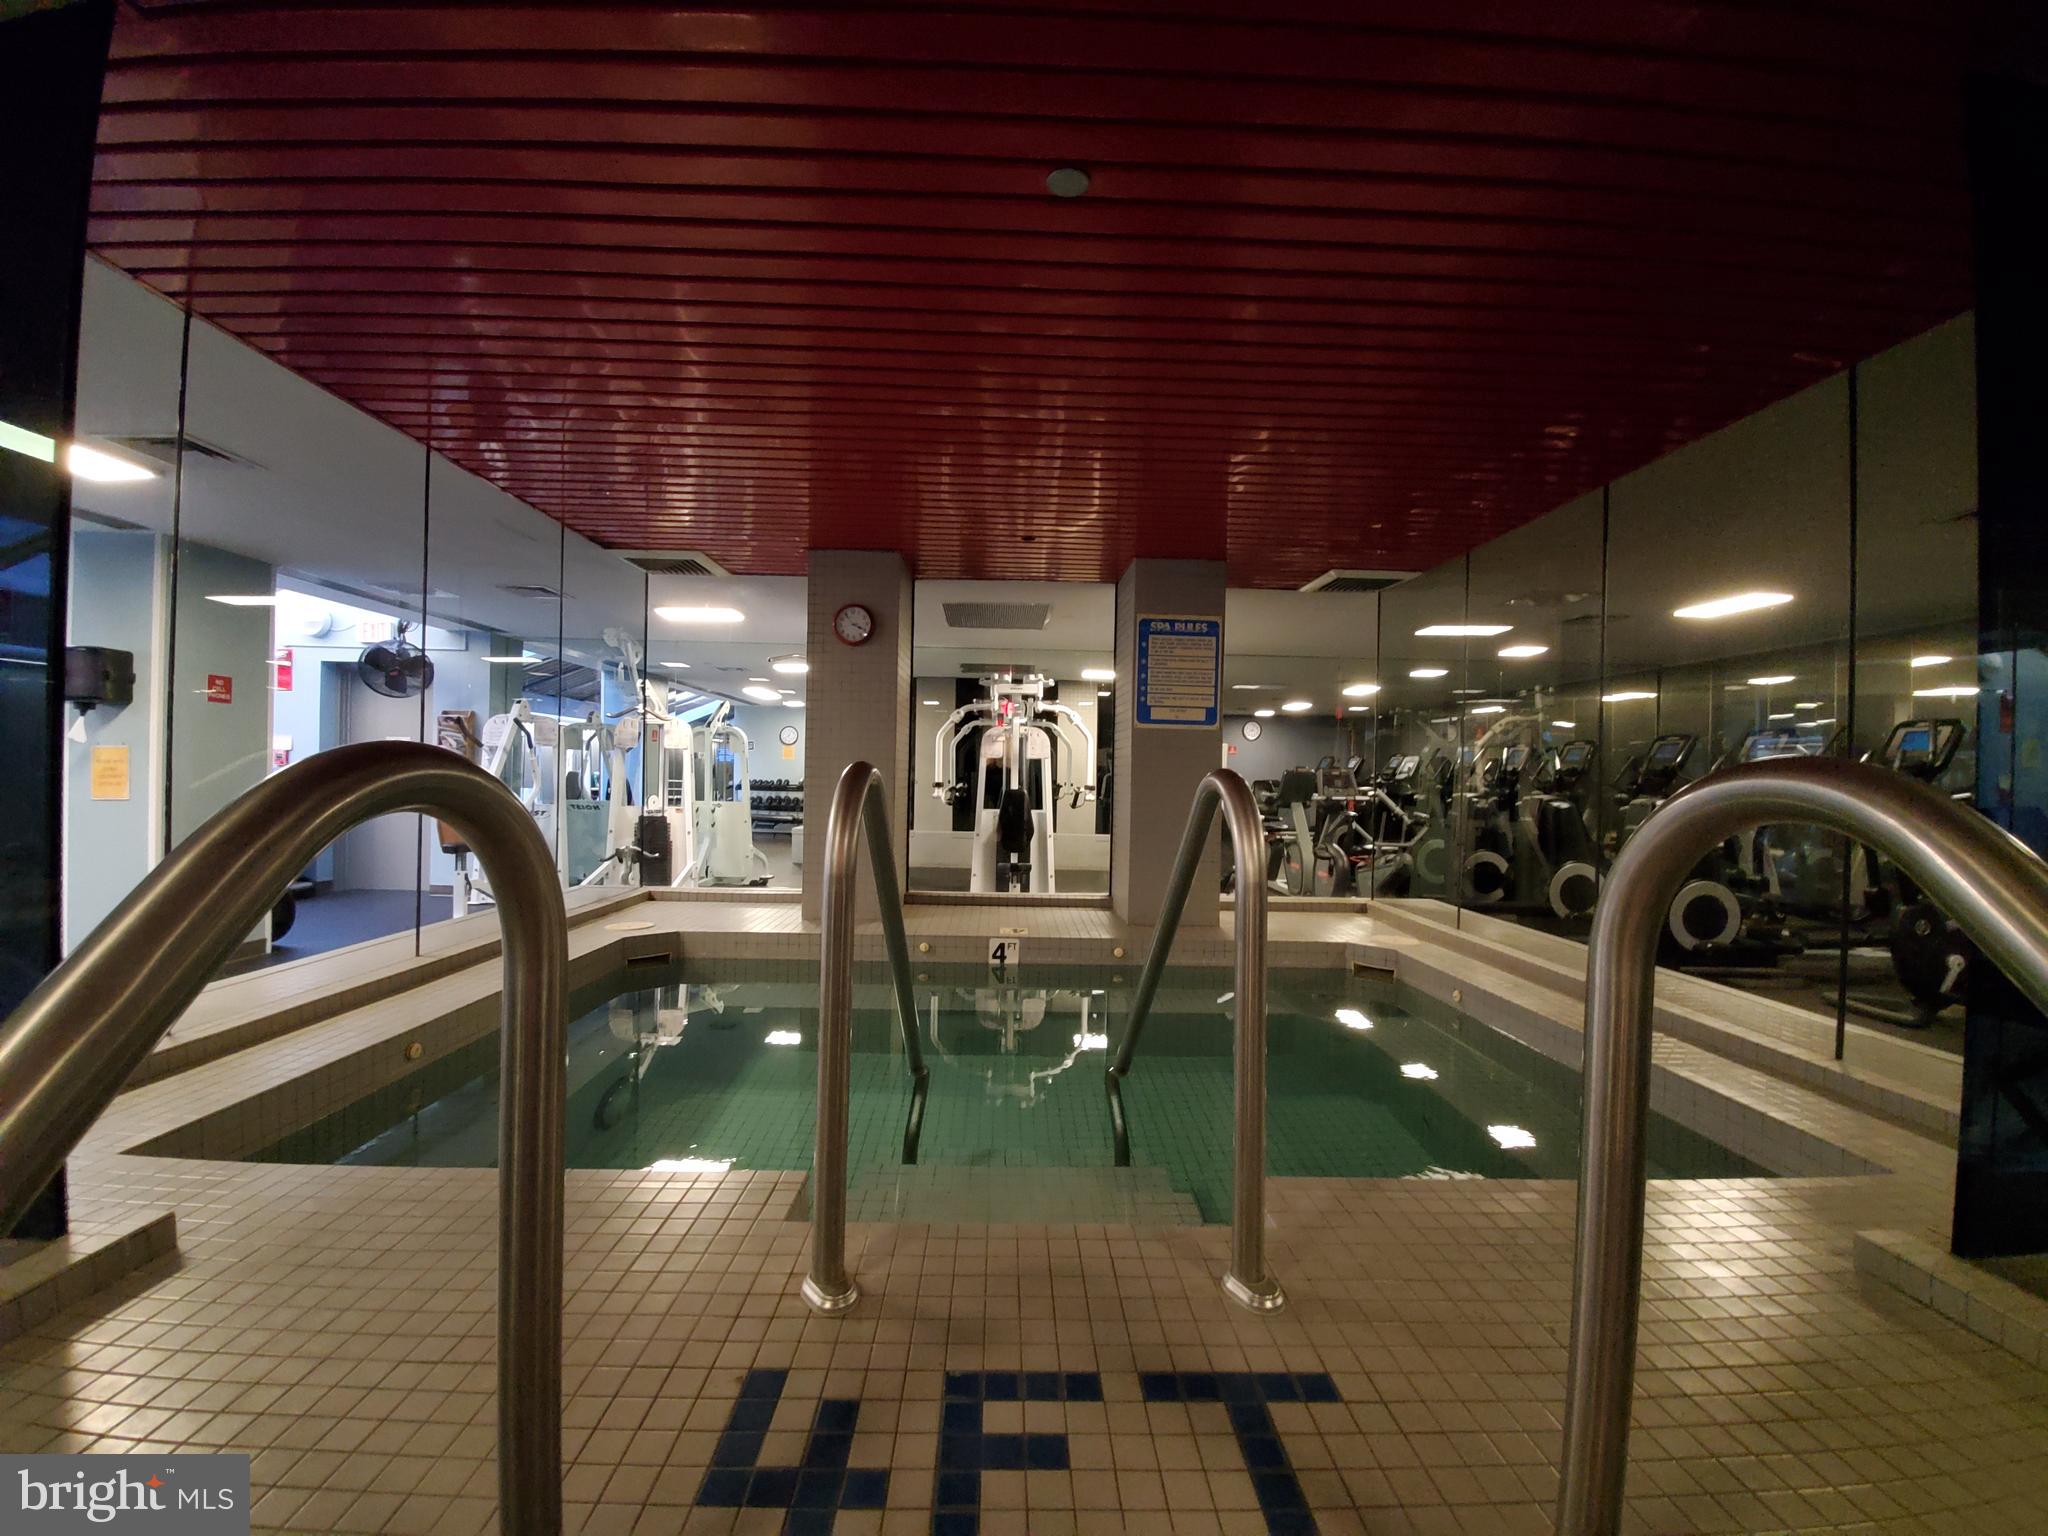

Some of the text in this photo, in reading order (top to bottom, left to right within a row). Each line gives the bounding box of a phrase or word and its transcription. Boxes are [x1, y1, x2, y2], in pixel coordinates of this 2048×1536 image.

[362, 622, 387, 640] EXIT
[1150, 621, 1208, 633] SPA RULES
[992, 942, 1017, 964] 4 FT
